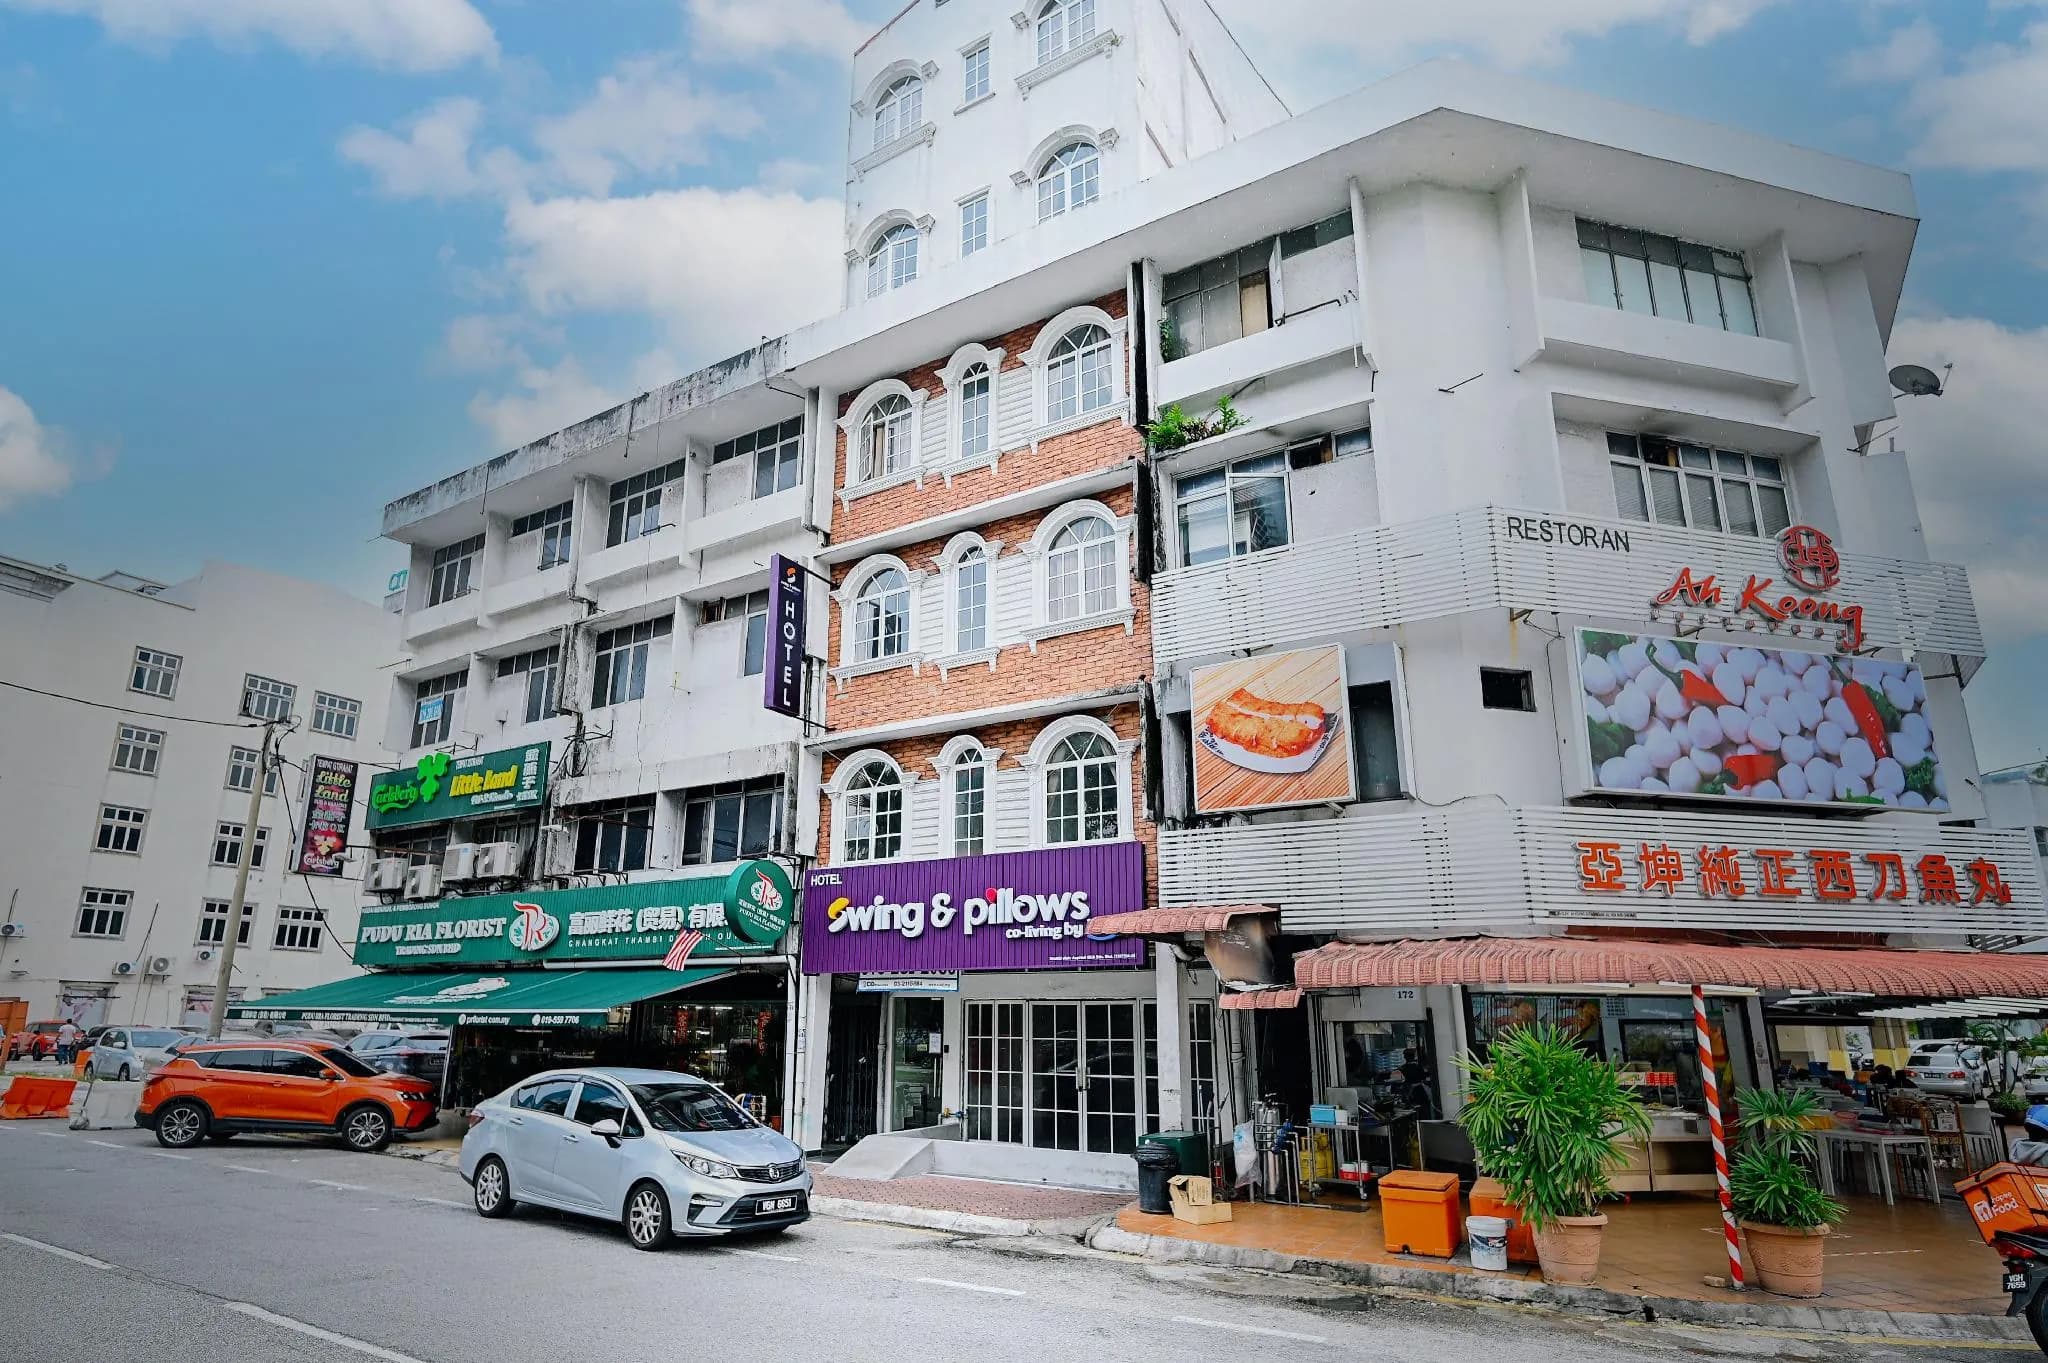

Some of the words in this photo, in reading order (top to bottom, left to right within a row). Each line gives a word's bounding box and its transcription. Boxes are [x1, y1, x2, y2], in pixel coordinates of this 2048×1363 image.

[1506, 516, 1631, 553] RESTORAN
[1655, 566, 1723, 604] Ah
[1739, 574, 1864, 650] Koong
[783, 599, 797, 707] HOTEL
[316, 770, 352, 788] Little
[449, 772, 484, 797] Little
[315, 785, 349, 802] Land
[371, 780, 420, 814] Carlsberg
[810, 873, 843, 886] HOTEL
[1576, 840, 2013, 906] 亞坤純正西刀魚丸
[688, 902, 729, 928] 有限
[930, 892, 958, 928] &
[963, 887, 1092, 935] pillows
[360, 924, 404, 944] PUDU
[404, 922, 433, 942] RIA
[433, 917, 508, 940] FLORIST
[568, 936, 619, 948] CHANGKAT
[625, 935, 663, 945] THAMBI
[1005, 924, 1063, 940] co-living
[1063, 921, 1084, 938] by
[1396, 990, 1414, 999] 172
[1991, 1197, 2019, 1217] Food
